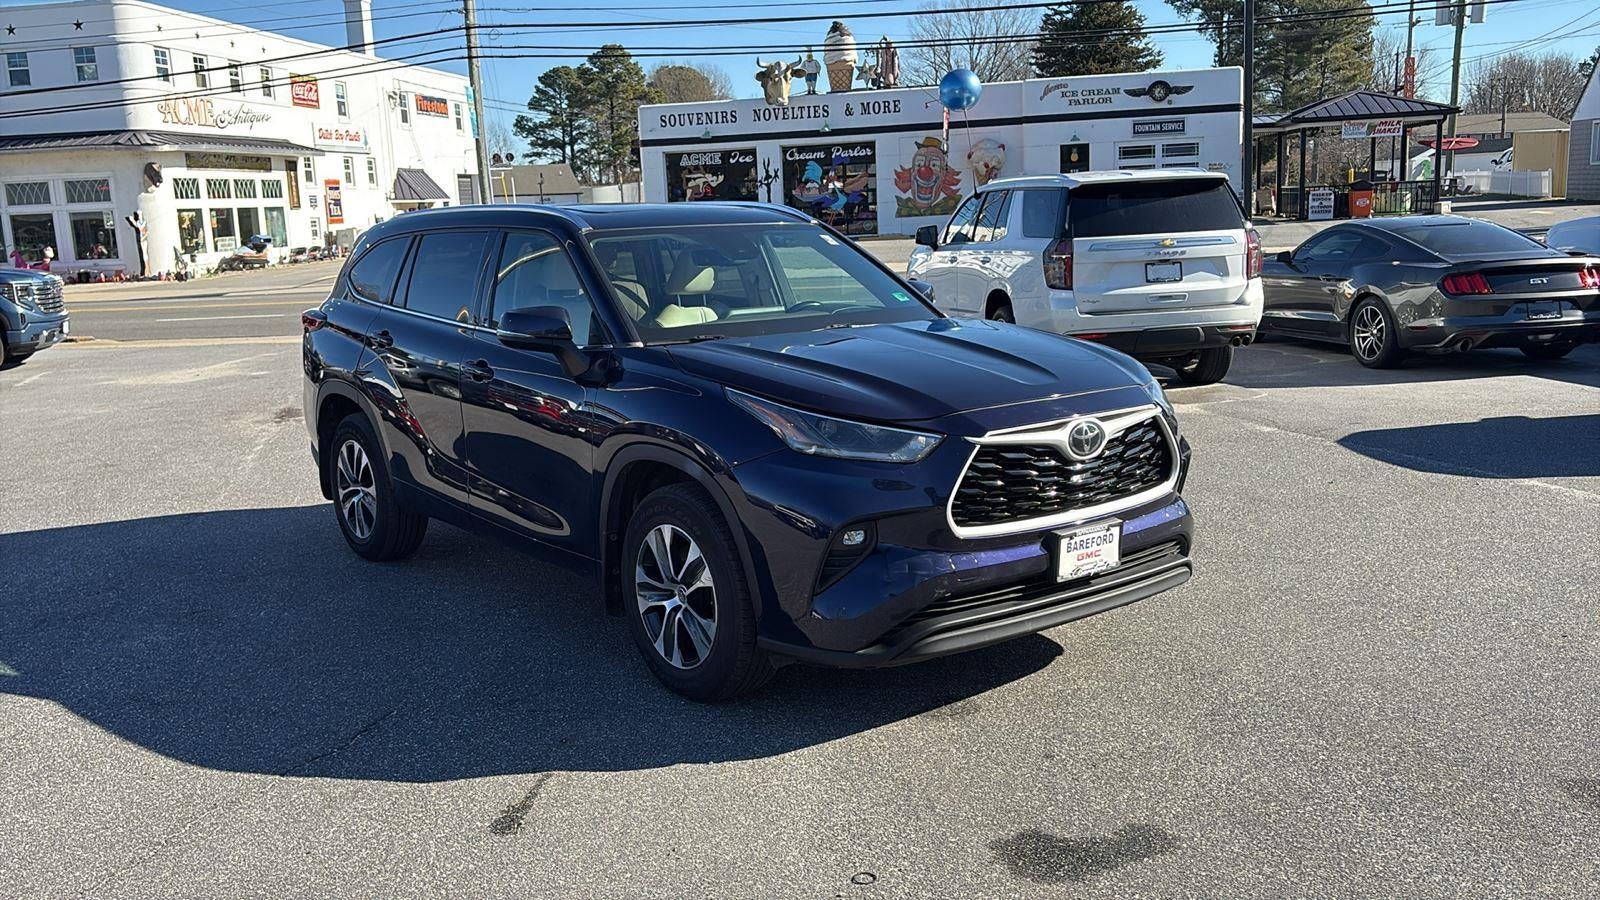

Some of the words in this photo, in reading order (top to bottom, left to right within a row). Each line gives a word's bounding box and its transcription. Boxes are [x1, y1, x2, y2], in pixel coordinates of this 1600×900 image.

[1080, 88, 1121, 97] CREAM
[1068, 97, 1112, 106] PARLOR
[157, 97, 216, 127] ACME
[659, 110, 738, 128] SOUVENIRS
[752, 104, 830, 122] NOVELTIES
[844, 103, 855, 117] &
[860, 99, 901, 115] MORE
[1134, 123, 1161, 133] FOUNTAIN
[1161, 122, 1183, 131] SERVICE
[679, 152, 722, 167] ACME
[729, 151, 754, 164] Ice
[785, 147, 826, 161] Cream
[831, 145, 873, 159] Parlor
[1066, 533, 1114, 553] BAREFORD
[1076, 549, 1102, 561] GMC
